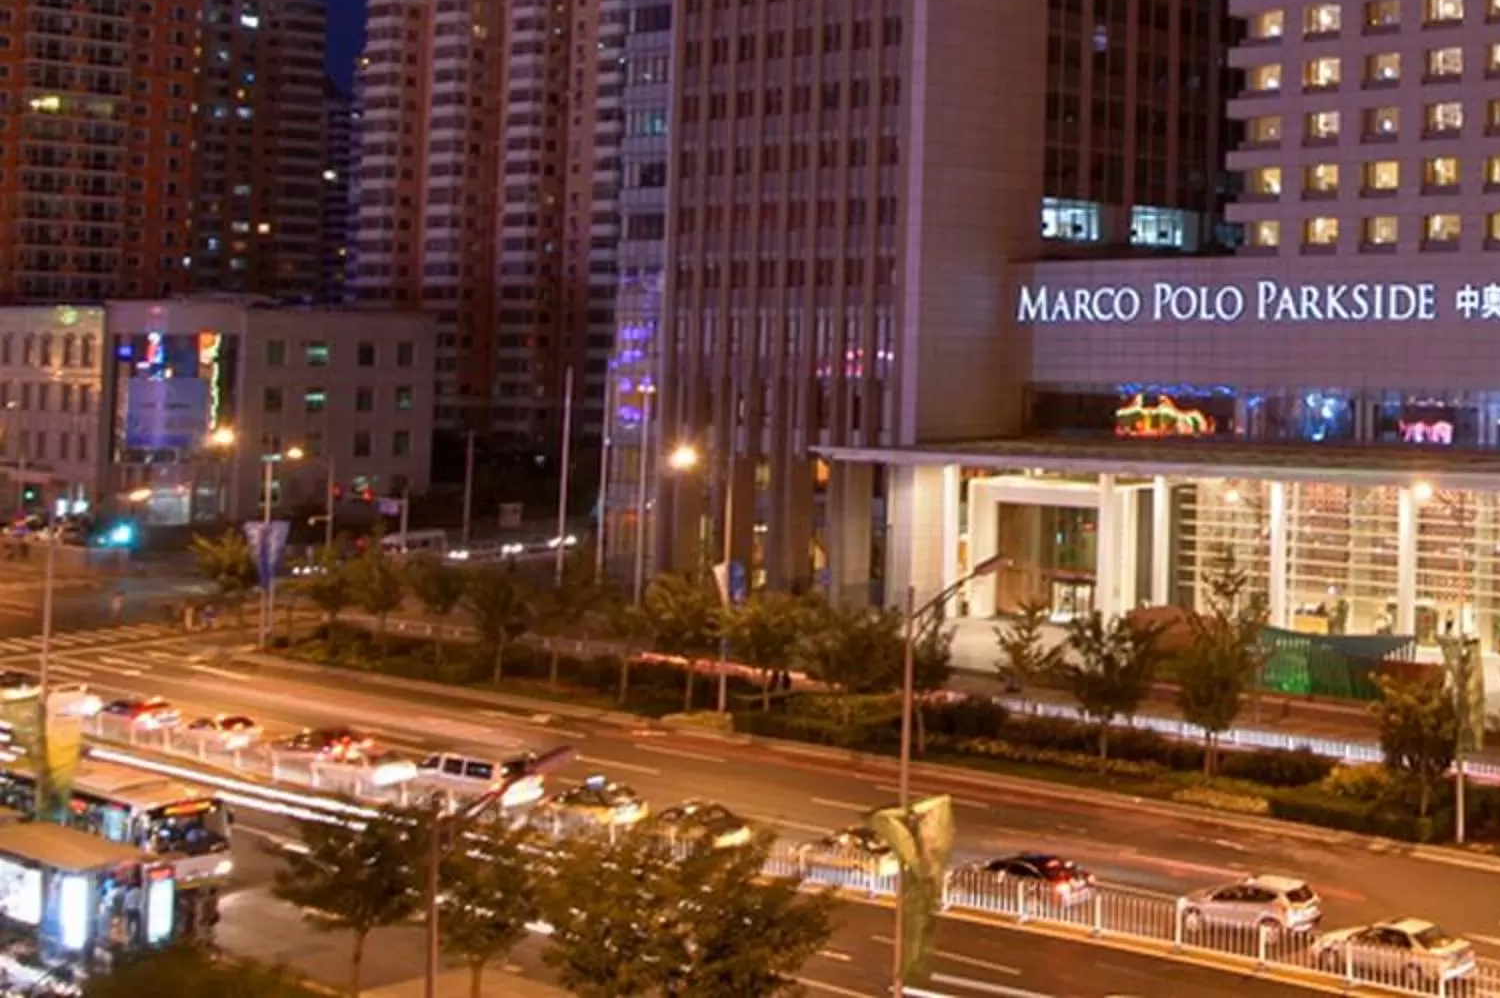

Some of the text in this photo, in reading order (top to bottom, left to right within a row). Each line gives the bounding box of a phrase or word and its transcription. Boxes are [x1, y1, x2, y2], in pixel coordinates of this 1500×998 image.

[1017, 286, 1141, 322] MARCO
[1153, 283, 1244, 322] POLO
[1257, 281, 1436, 321] PARKSIDE
